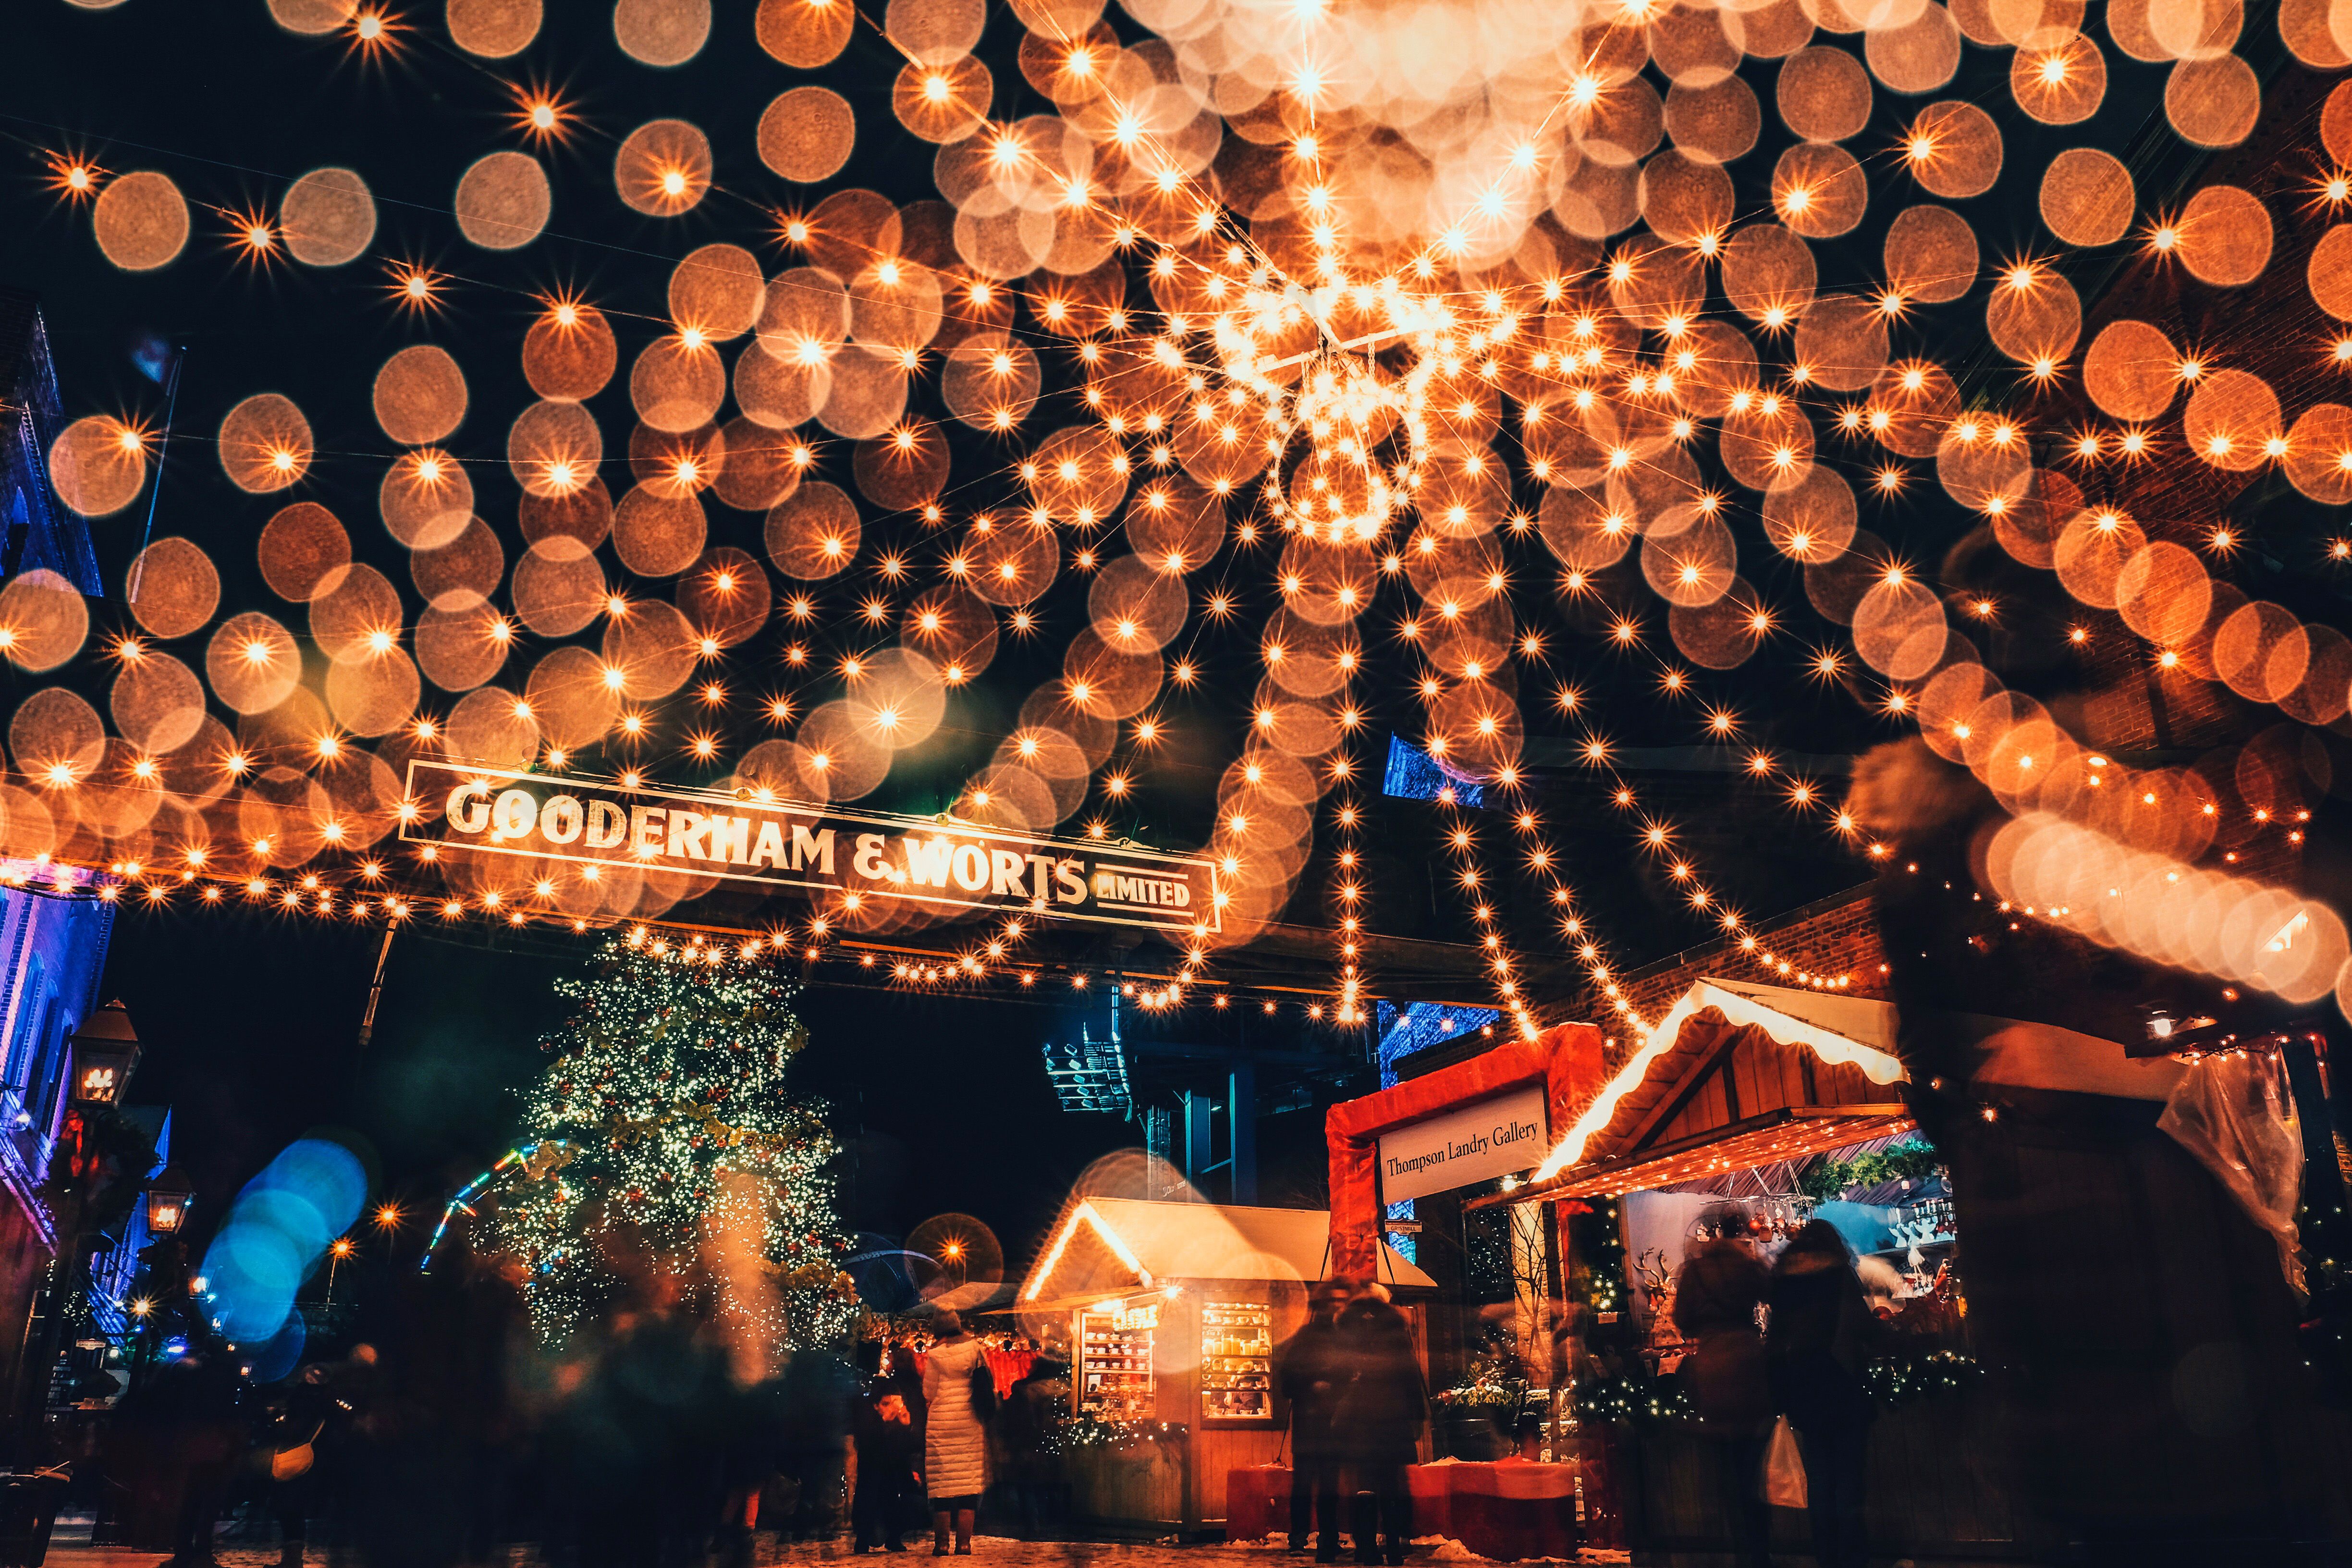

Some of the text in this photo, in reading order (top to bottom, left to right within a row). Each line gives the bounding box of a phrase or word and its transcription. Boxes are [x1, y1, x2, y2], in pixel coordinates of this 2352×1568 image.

[446, 784, 1190, 907] GOODERHAM & WORTS LIMITED
[1387, 1121, 1538, 1176] Thompson Landry Gallery
